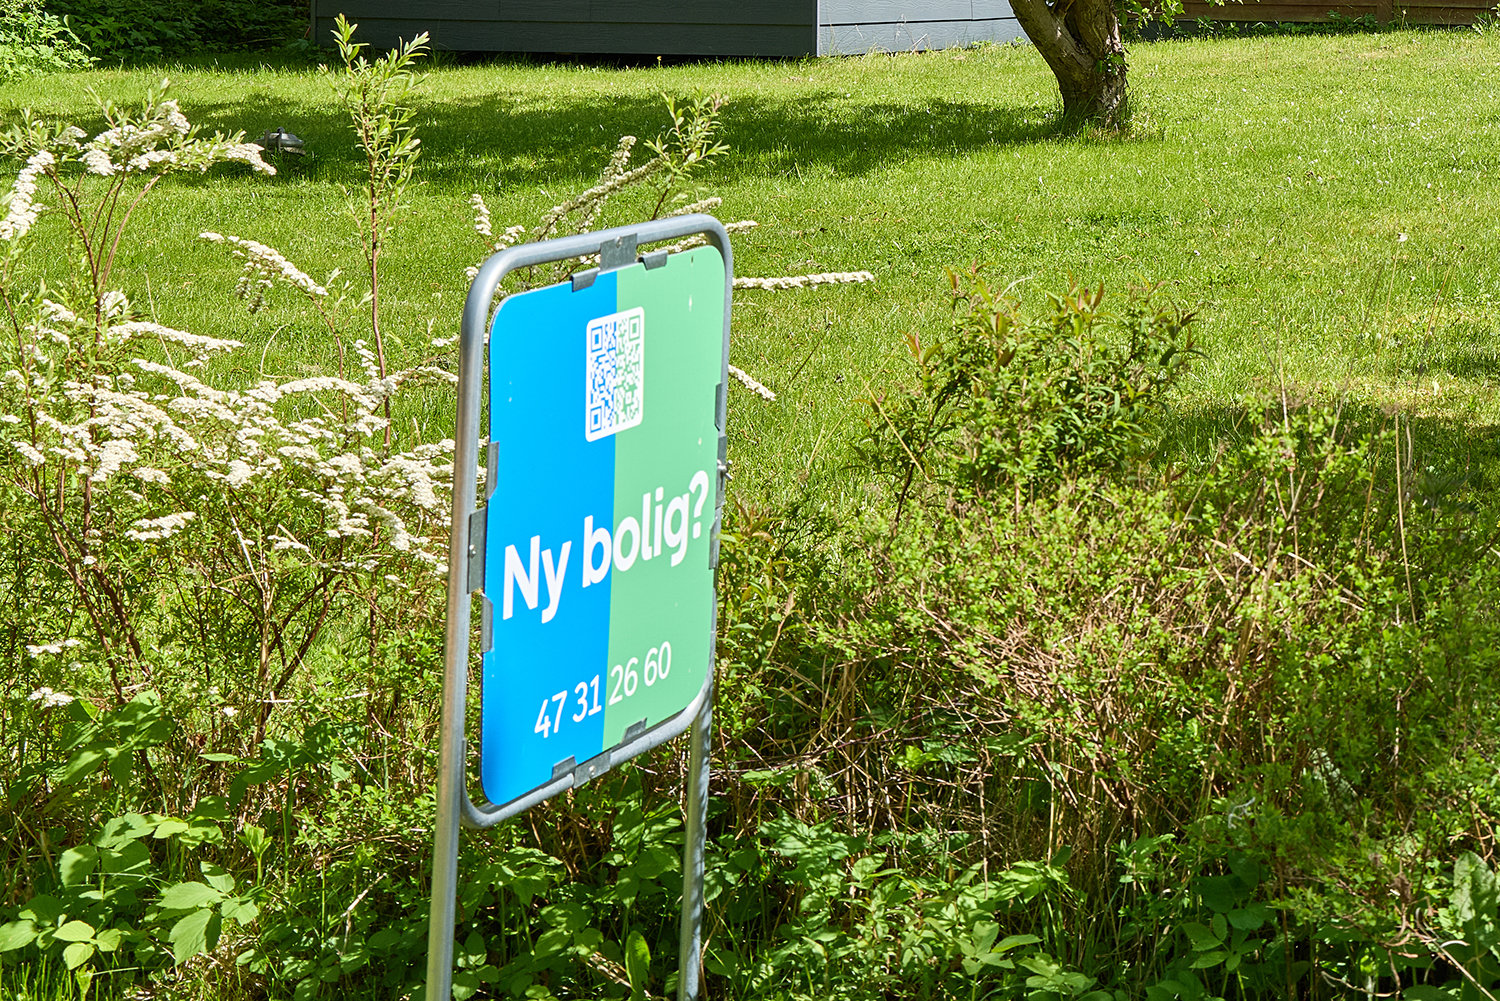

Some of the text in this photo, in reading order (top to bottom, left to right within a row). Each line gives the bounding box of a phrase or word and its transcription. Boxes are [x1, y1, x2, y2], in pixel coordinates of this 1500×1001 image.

[502, 470, 709, 624] Ny bolig?
[534, 641, 671, 738] 47 31 26 60
